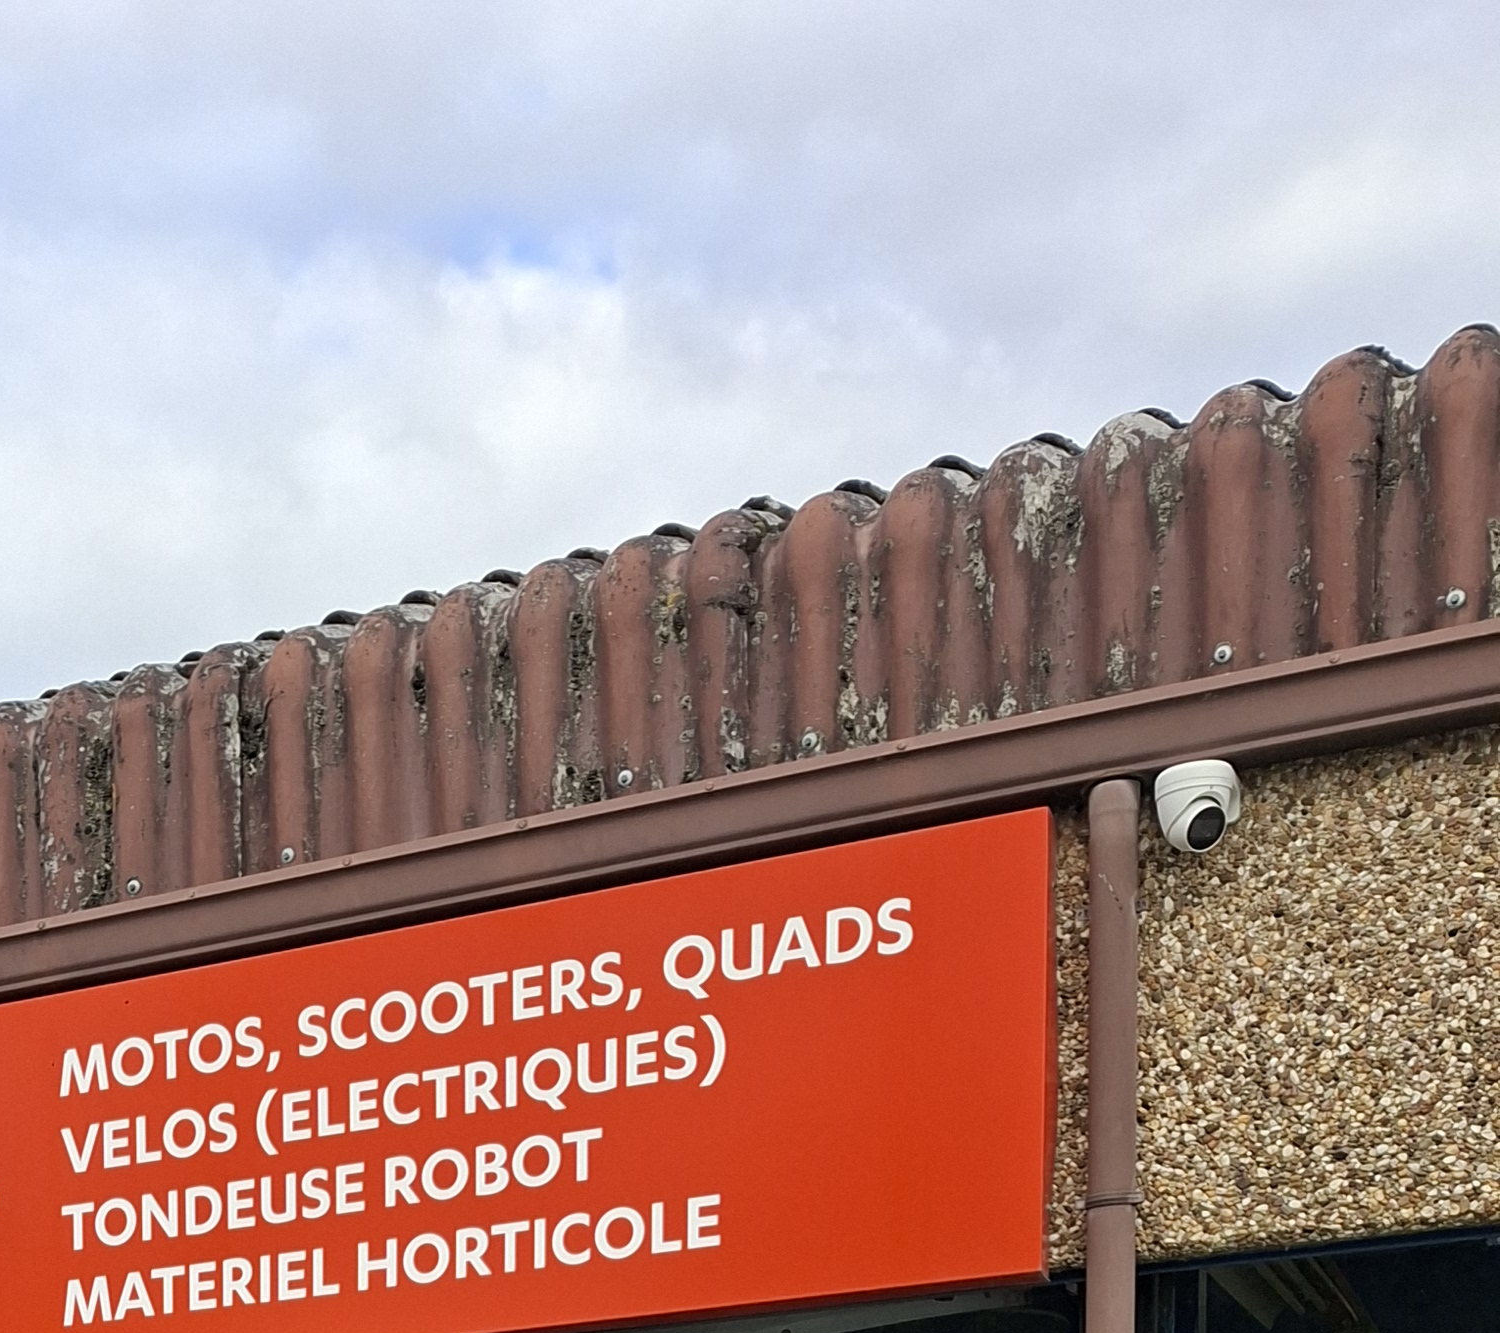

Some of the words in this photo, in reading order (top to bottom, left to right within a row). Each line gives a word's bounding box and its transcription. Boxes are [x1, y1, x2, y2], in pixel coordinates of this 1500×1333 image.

[59, 1016, 281, 1097] MOTOS,
[297, 951, 642, 1057] SCOOTERS,
[663, 897, 913, 1000] QUADS
[60, 1102, 238, 1174] VELOS
[255, 1014, 726, 1156] (ELECTRIQUES)
[61, 1162, 365, 1251] TONDEUSE
[384, 1127, 603, 1208] ROBOT
[63, 1247, 340, 1327] MATERIEL
[357, 1193, 721, 1292] HORTICOLE
